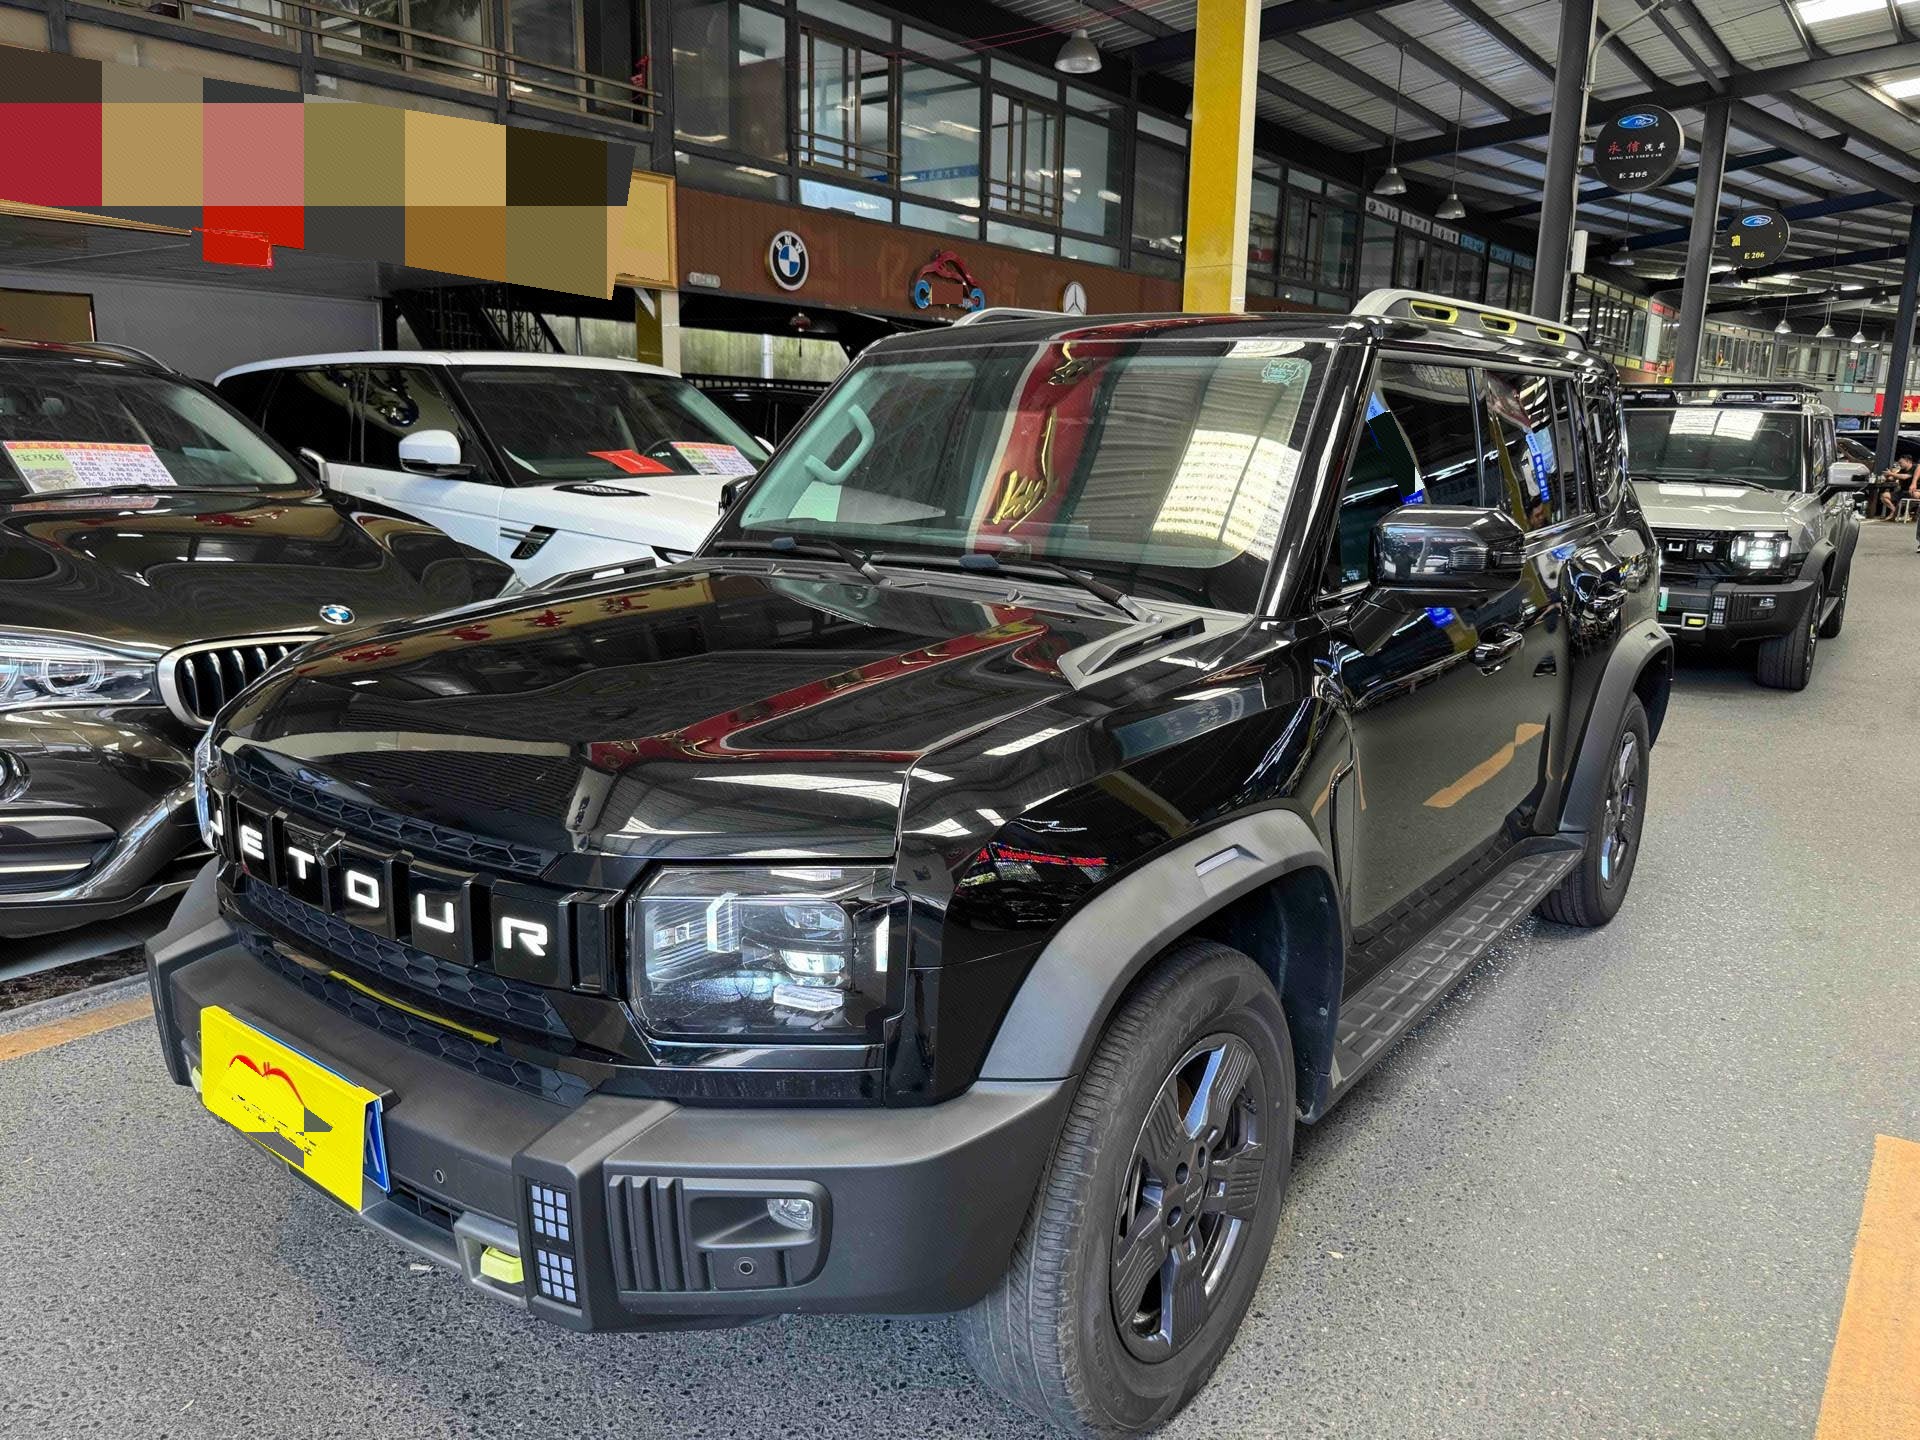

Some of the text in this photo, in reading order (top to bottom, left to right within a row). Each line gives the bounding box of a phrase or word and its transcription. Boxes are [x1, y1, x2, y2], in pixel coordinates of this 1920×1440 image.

[1608, 141, 1666, 154] 永信汽车
[1628, 171, 1648, 179] 205
[775, 235, 803, 254] BMW
[209, 809, 548, 957] JETOUR
